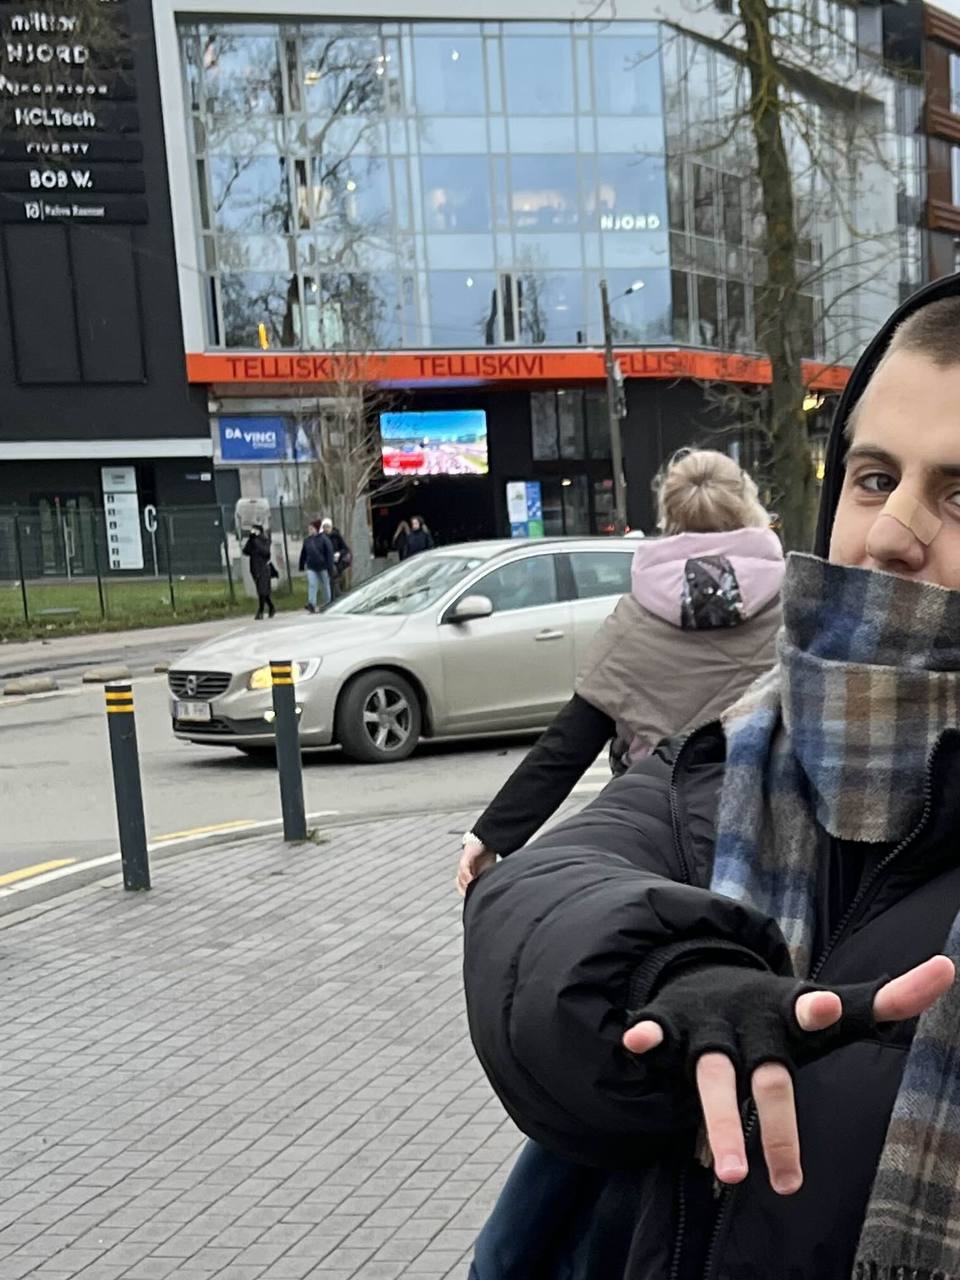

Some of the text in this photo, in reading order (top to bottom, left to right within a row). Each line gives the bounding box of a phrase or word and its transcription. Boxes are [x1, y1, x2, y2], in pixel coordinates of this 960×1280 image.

[6, 43, 90, 64] NJORD
[29, 169, 93, 189] BOB W.
[600, 213, 661, 231] NJORD
[414, 354, 545, 377] TELLISKIVI
[224, 427, 277, 443] DA VINCI
